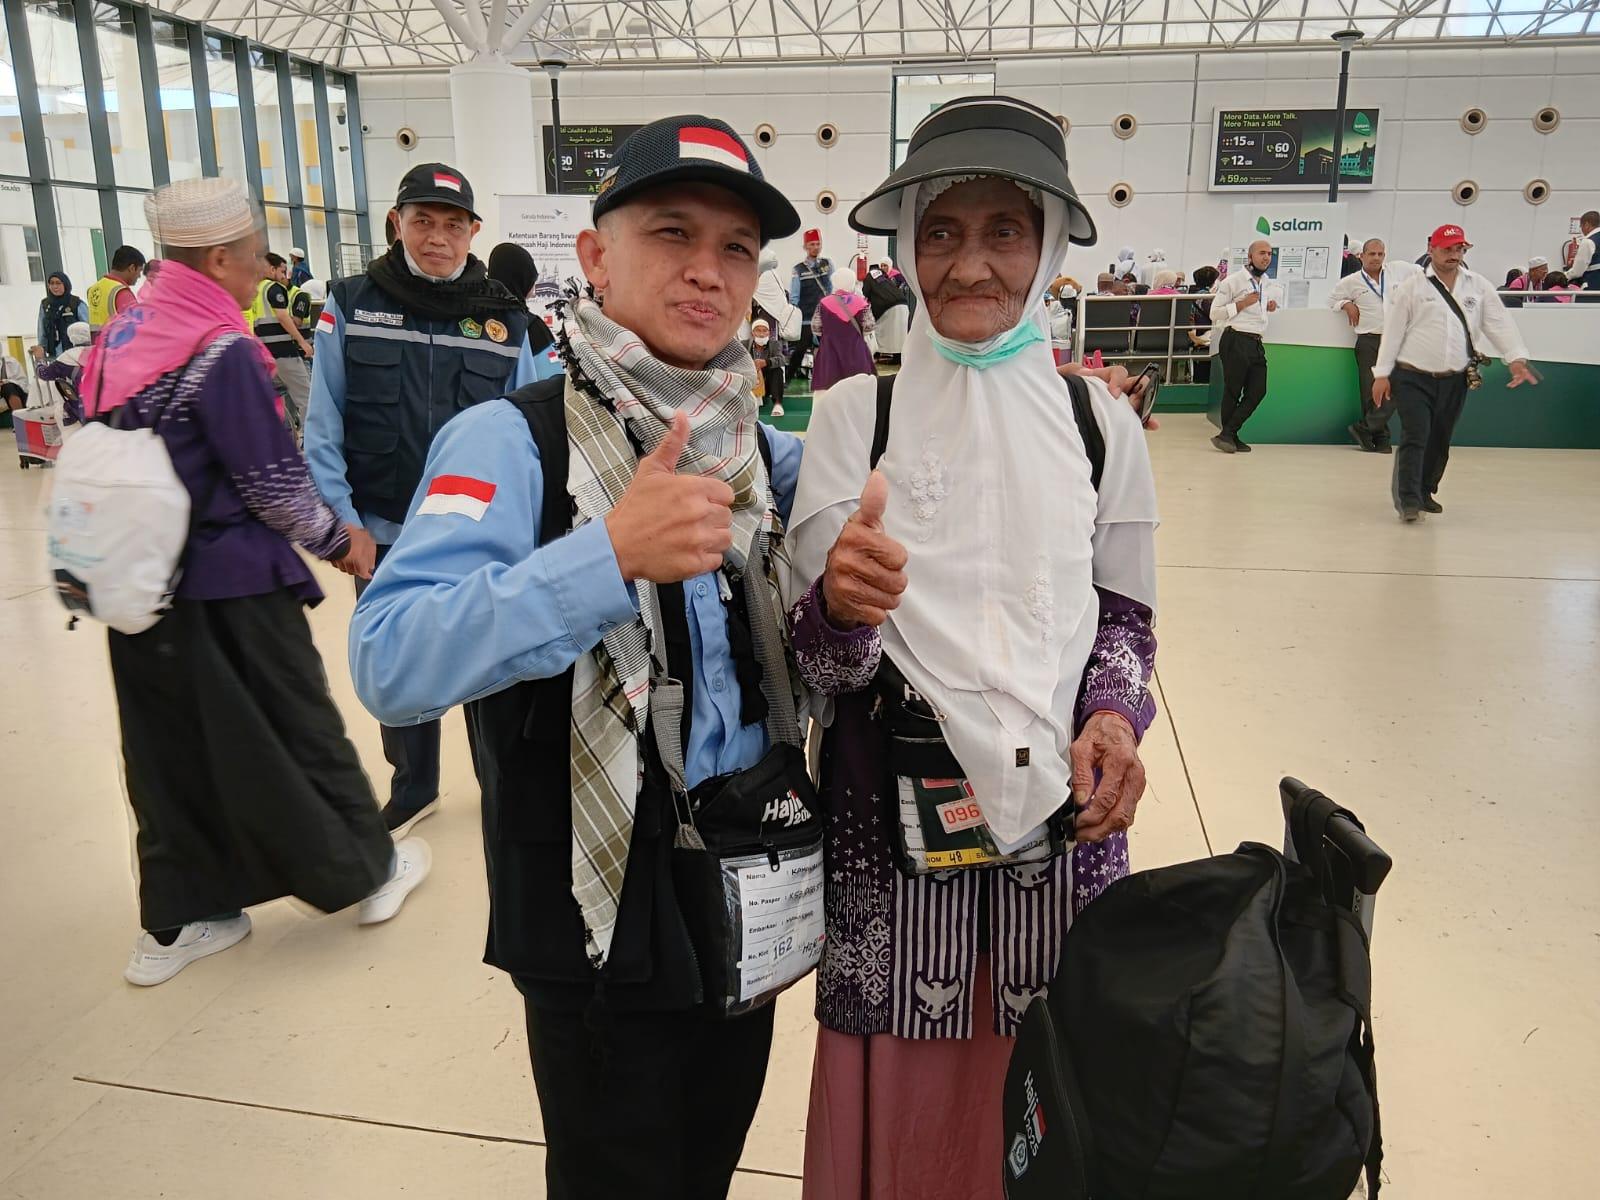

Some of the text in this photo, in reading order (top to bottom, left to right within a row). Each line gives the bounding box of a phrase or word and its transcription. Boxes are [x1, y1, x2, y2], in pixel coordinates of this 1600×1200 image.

[1233, 135, 1247, 146] 15
[1275, 143, 1290, 153] 60
[594, 149, 606, 159] 15
[1231, 155, 1244, 166] 12
[1272, 218, 1322, 232] salam
[508, 232, 538, 240] Ketentuan
[539, 232, 560, 241] Barang
[537, 241, 549, 250] Haji
[761, 790, 799, 828] Haji
[944, 804, 980, 825] 096
[949, 851, 963, 864] 48
[746, 873, 766, 881] Nama
[761, 896, 781, 906] Paspor
[772, 936, 794, 961] 162
[1024, 1069, 1039, 1121] Haji
[1025, 1118, 1039, 1157] 2025
